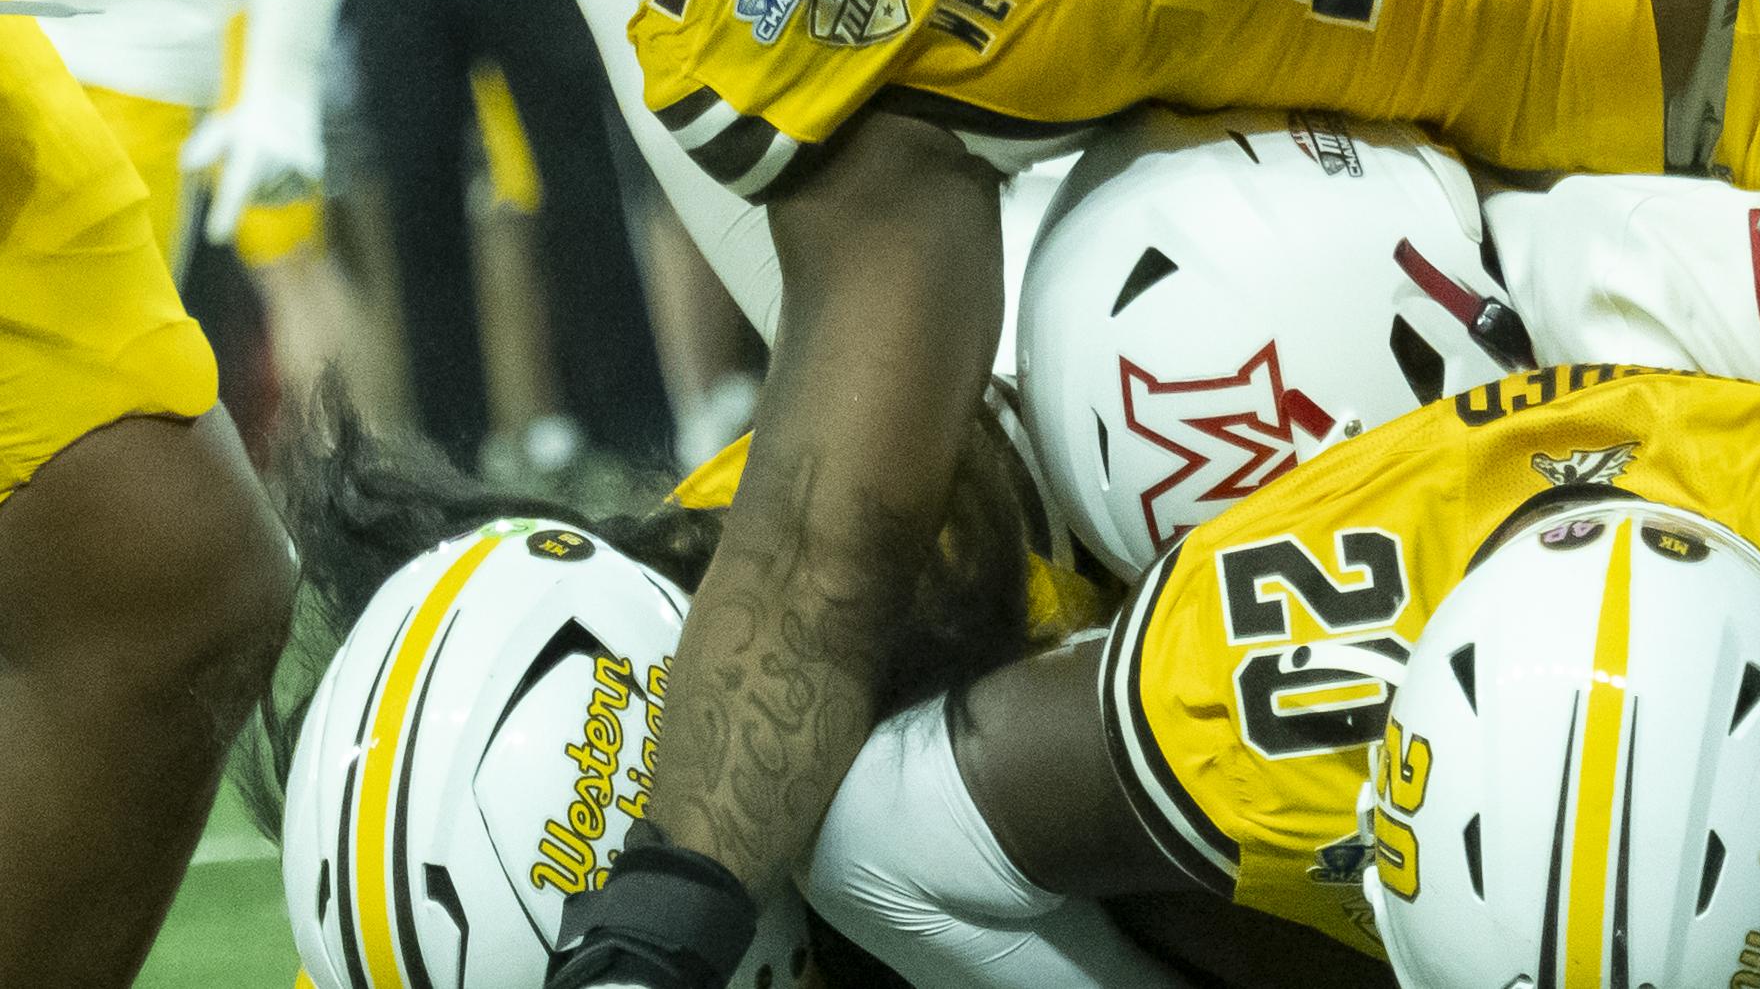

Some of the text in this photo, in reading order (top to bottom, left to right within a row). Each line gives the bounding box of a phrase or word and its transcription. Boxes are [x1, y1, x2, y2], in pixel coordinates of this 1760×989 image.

[1214, 526, 1413, 762] 20
[530, 656, 633, 894] Western
[1374, 715, 1434, 905] 20
